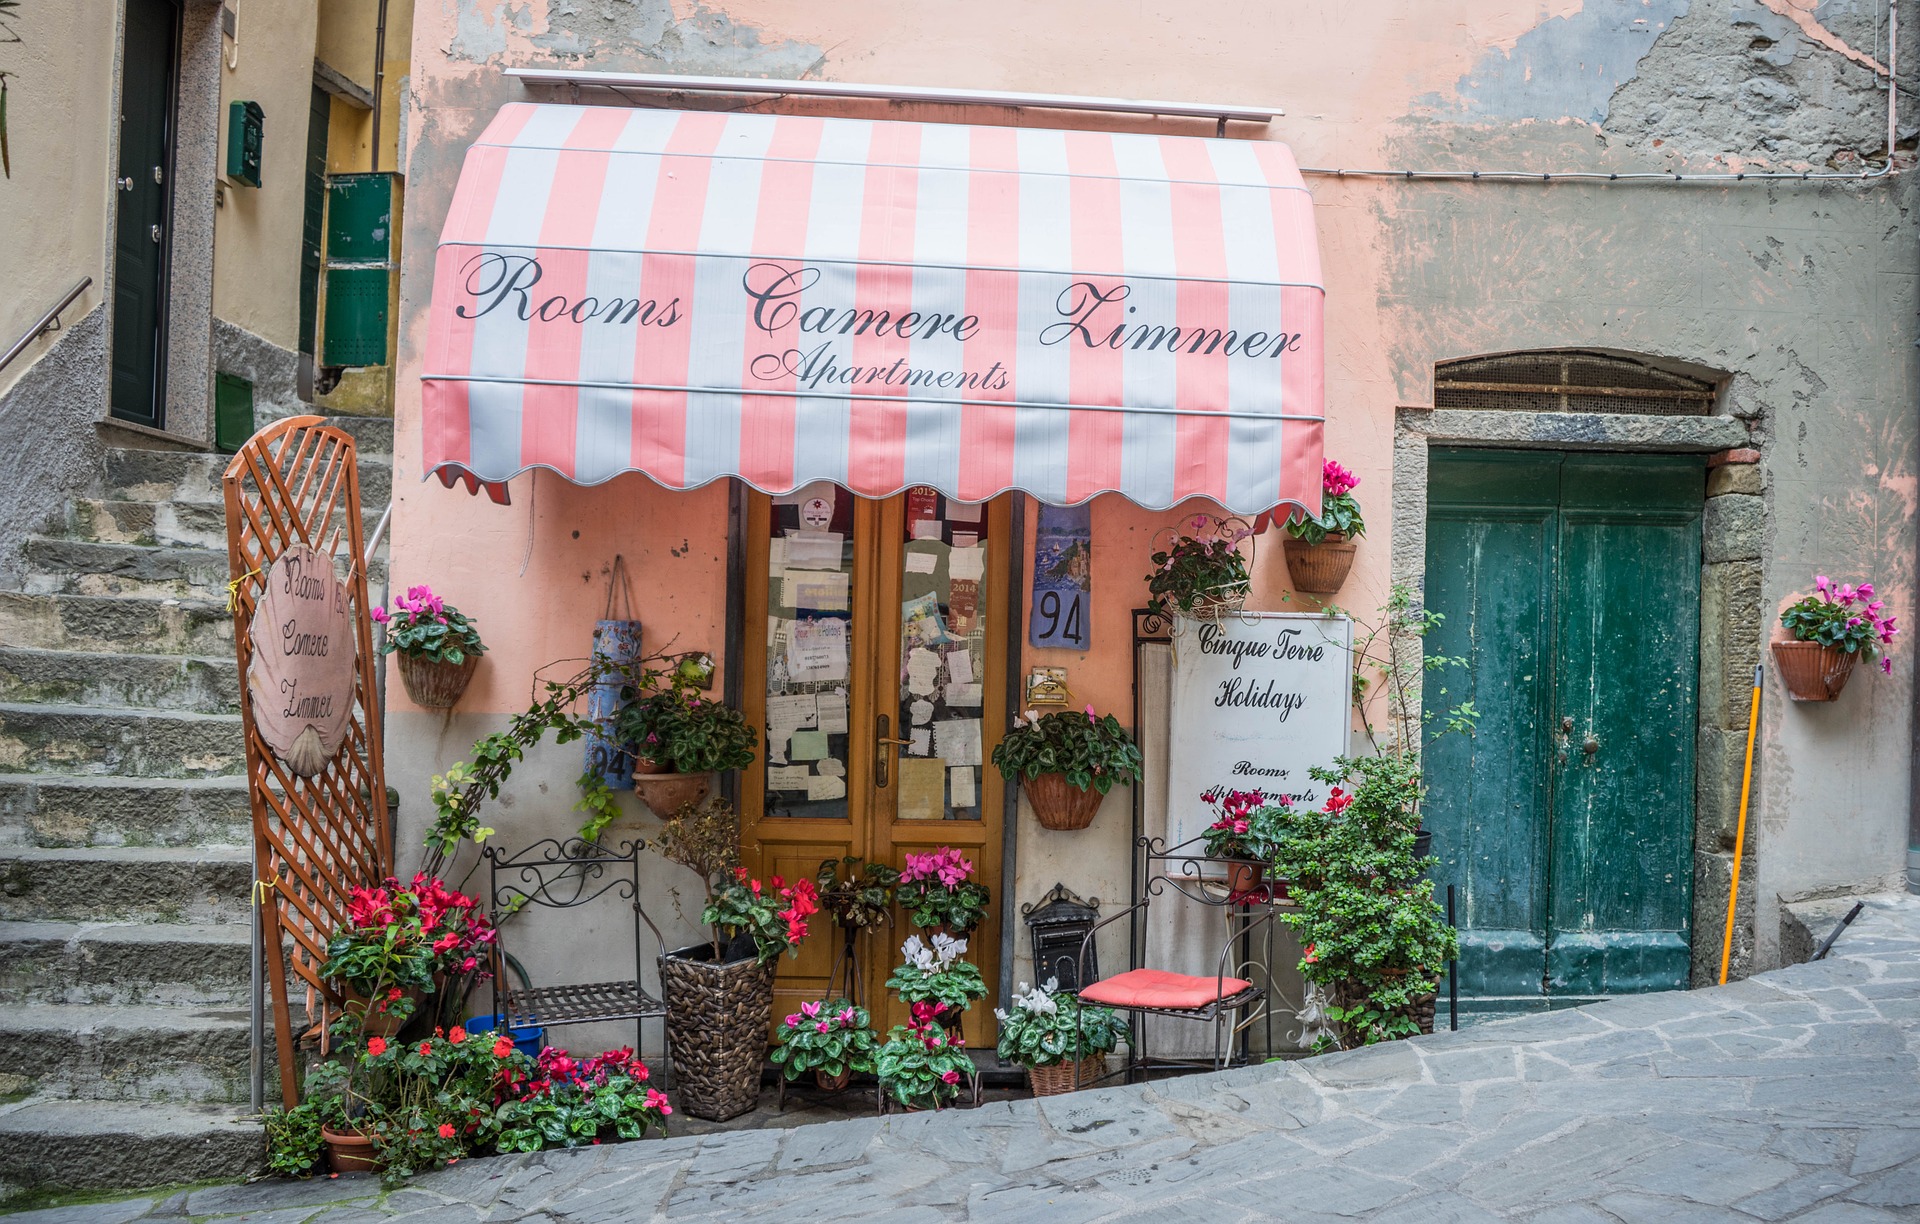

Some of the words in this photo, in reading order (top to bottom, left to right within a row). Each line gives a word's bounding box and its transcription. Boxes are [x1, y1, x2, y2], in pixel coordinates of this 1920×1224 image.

[455, 252, 683, 327] Rooms
[742, 263, 980, 342] Camere
[1039, 282, 1301, 358] Zimmer
[750, 340, 1010, 390] Apartments
[911, 487, 936, 497] 2015
[284, 554, 325, 601] Rooms
[952, 583, 977, 593] 2014
[1039, 590, 1083, 645] 94
[1198, 623, 1272, 670] Cinque
[1272, 628, 1325, 662] Terre
[280, 678, 333, 719] Zimmer
[1214, 676, 1308, 723] Holidays
[592, 745, 626, 782] 94
